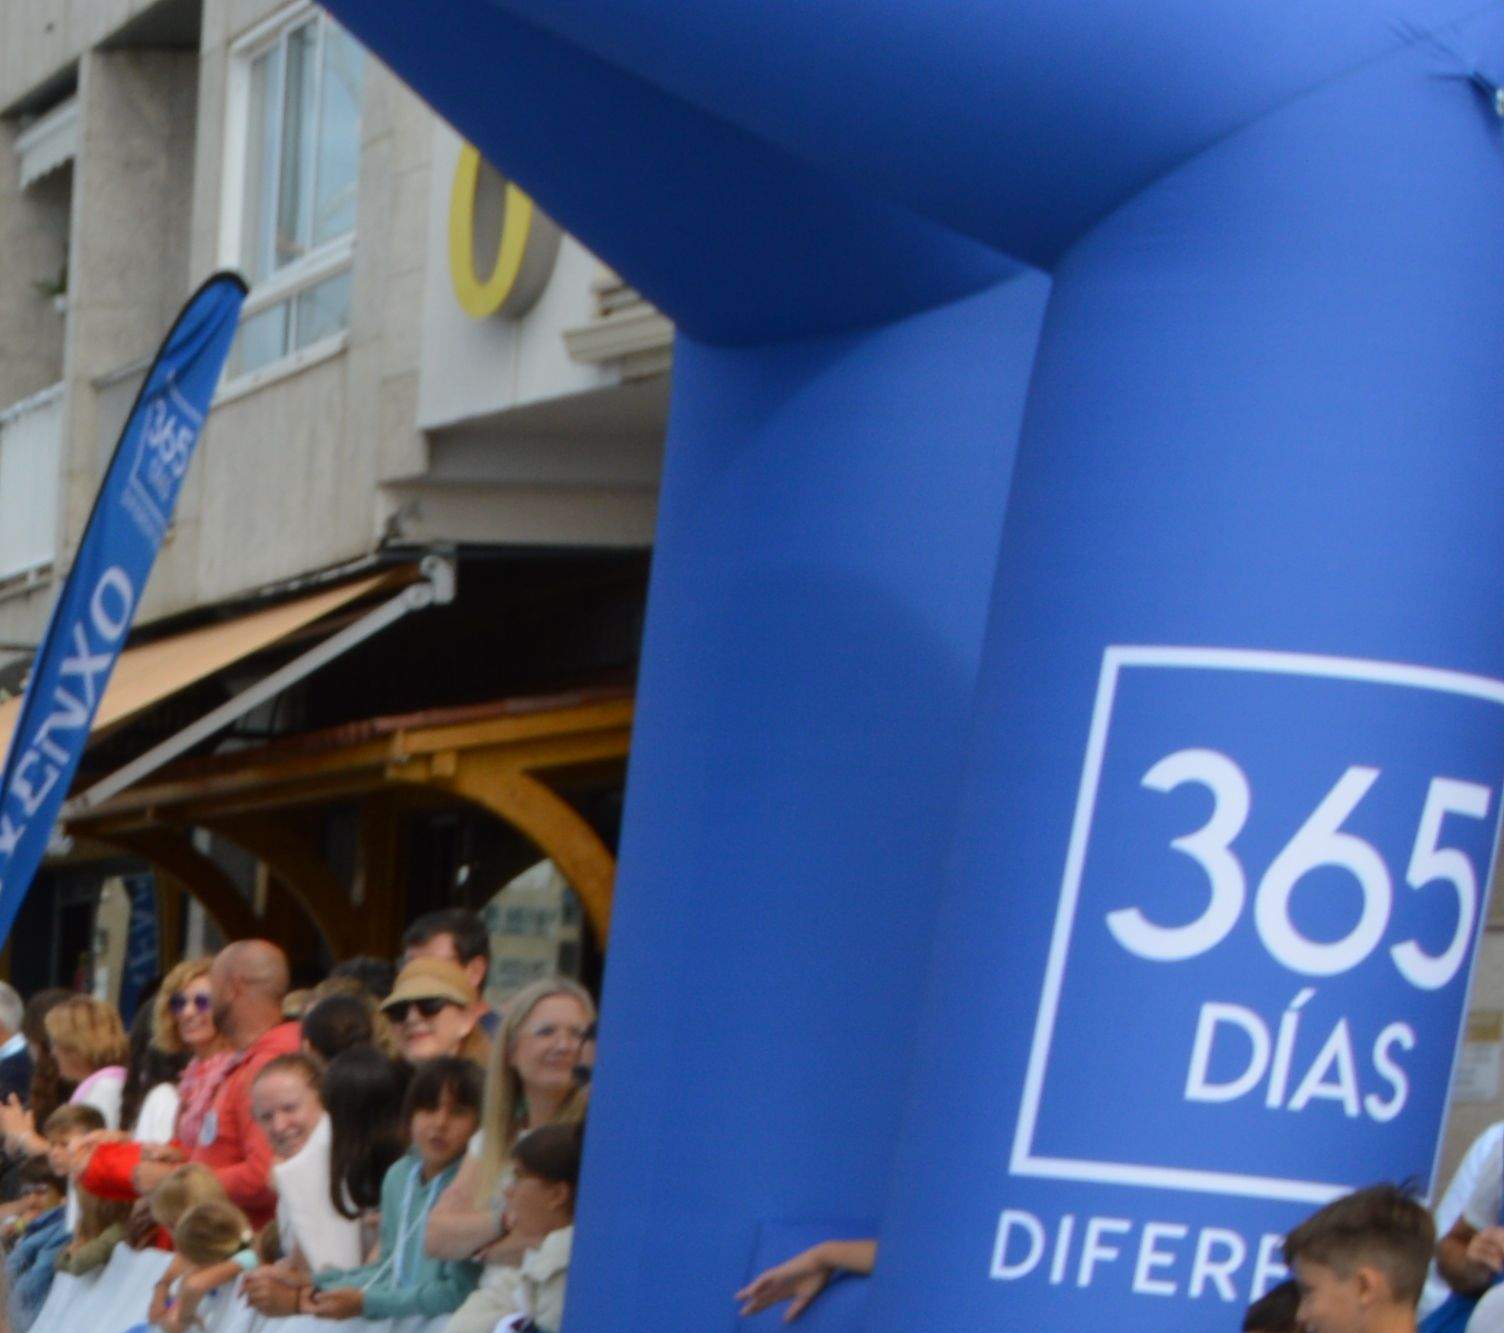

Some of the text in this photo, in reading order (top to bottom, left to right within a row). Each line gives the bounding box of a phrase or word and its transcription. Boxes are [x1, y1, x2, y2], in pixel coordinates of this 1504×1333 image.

[1105, 748, 1492, 990] 365
[1185, 987, 1416, 1122] DÍAS
[989, 1209, 1294, 1302] DIFERE
